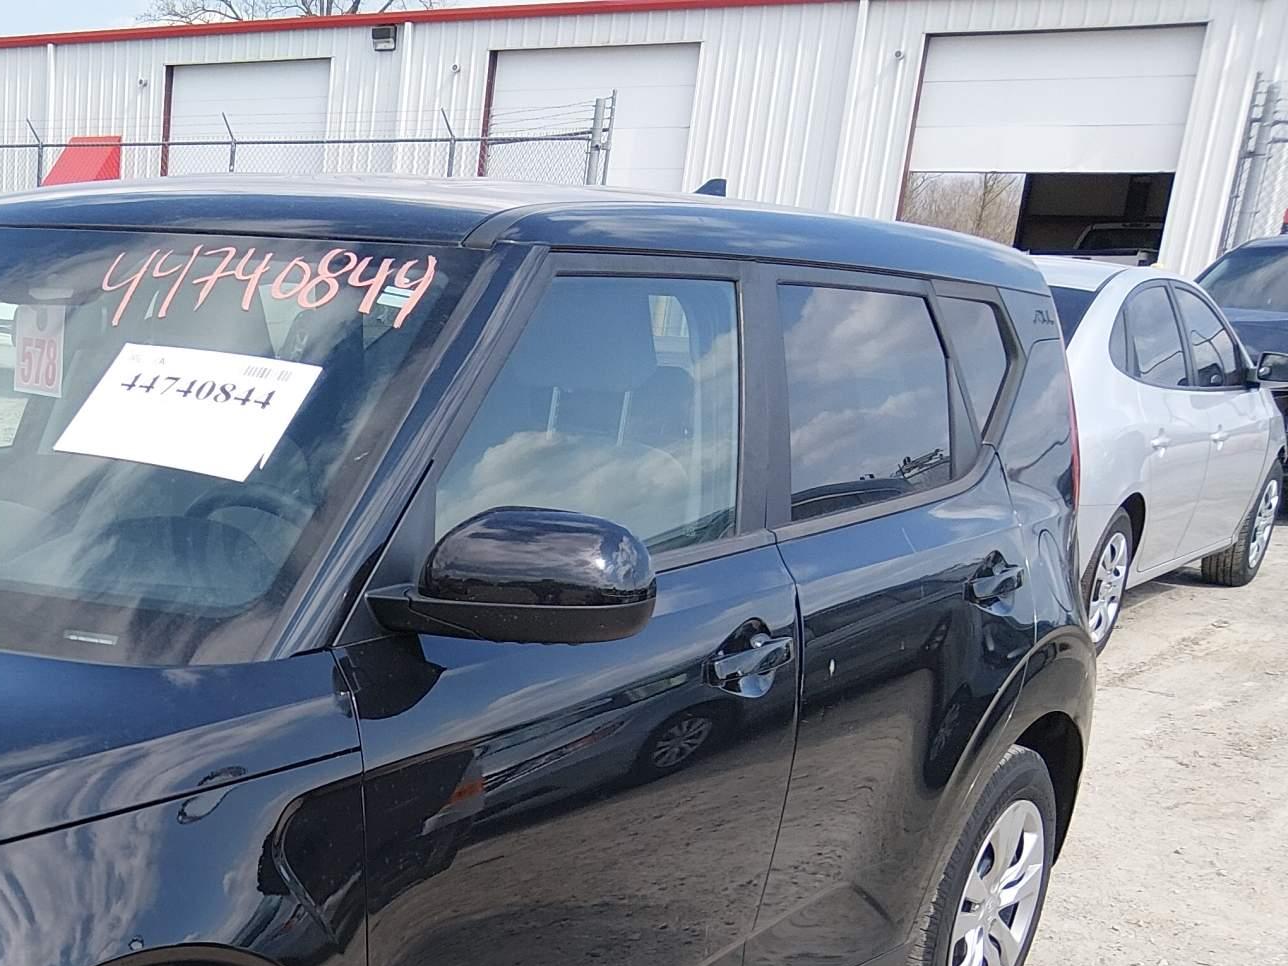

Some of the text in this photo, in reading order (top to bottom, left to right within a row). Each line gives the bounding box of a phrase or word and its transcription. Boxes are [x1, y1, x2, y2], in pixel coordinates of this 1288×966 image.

[101, 244, 438, 328] 44740844
[20, 336, 58, 388] 578
[120, 372, 277, 410] 44740844
